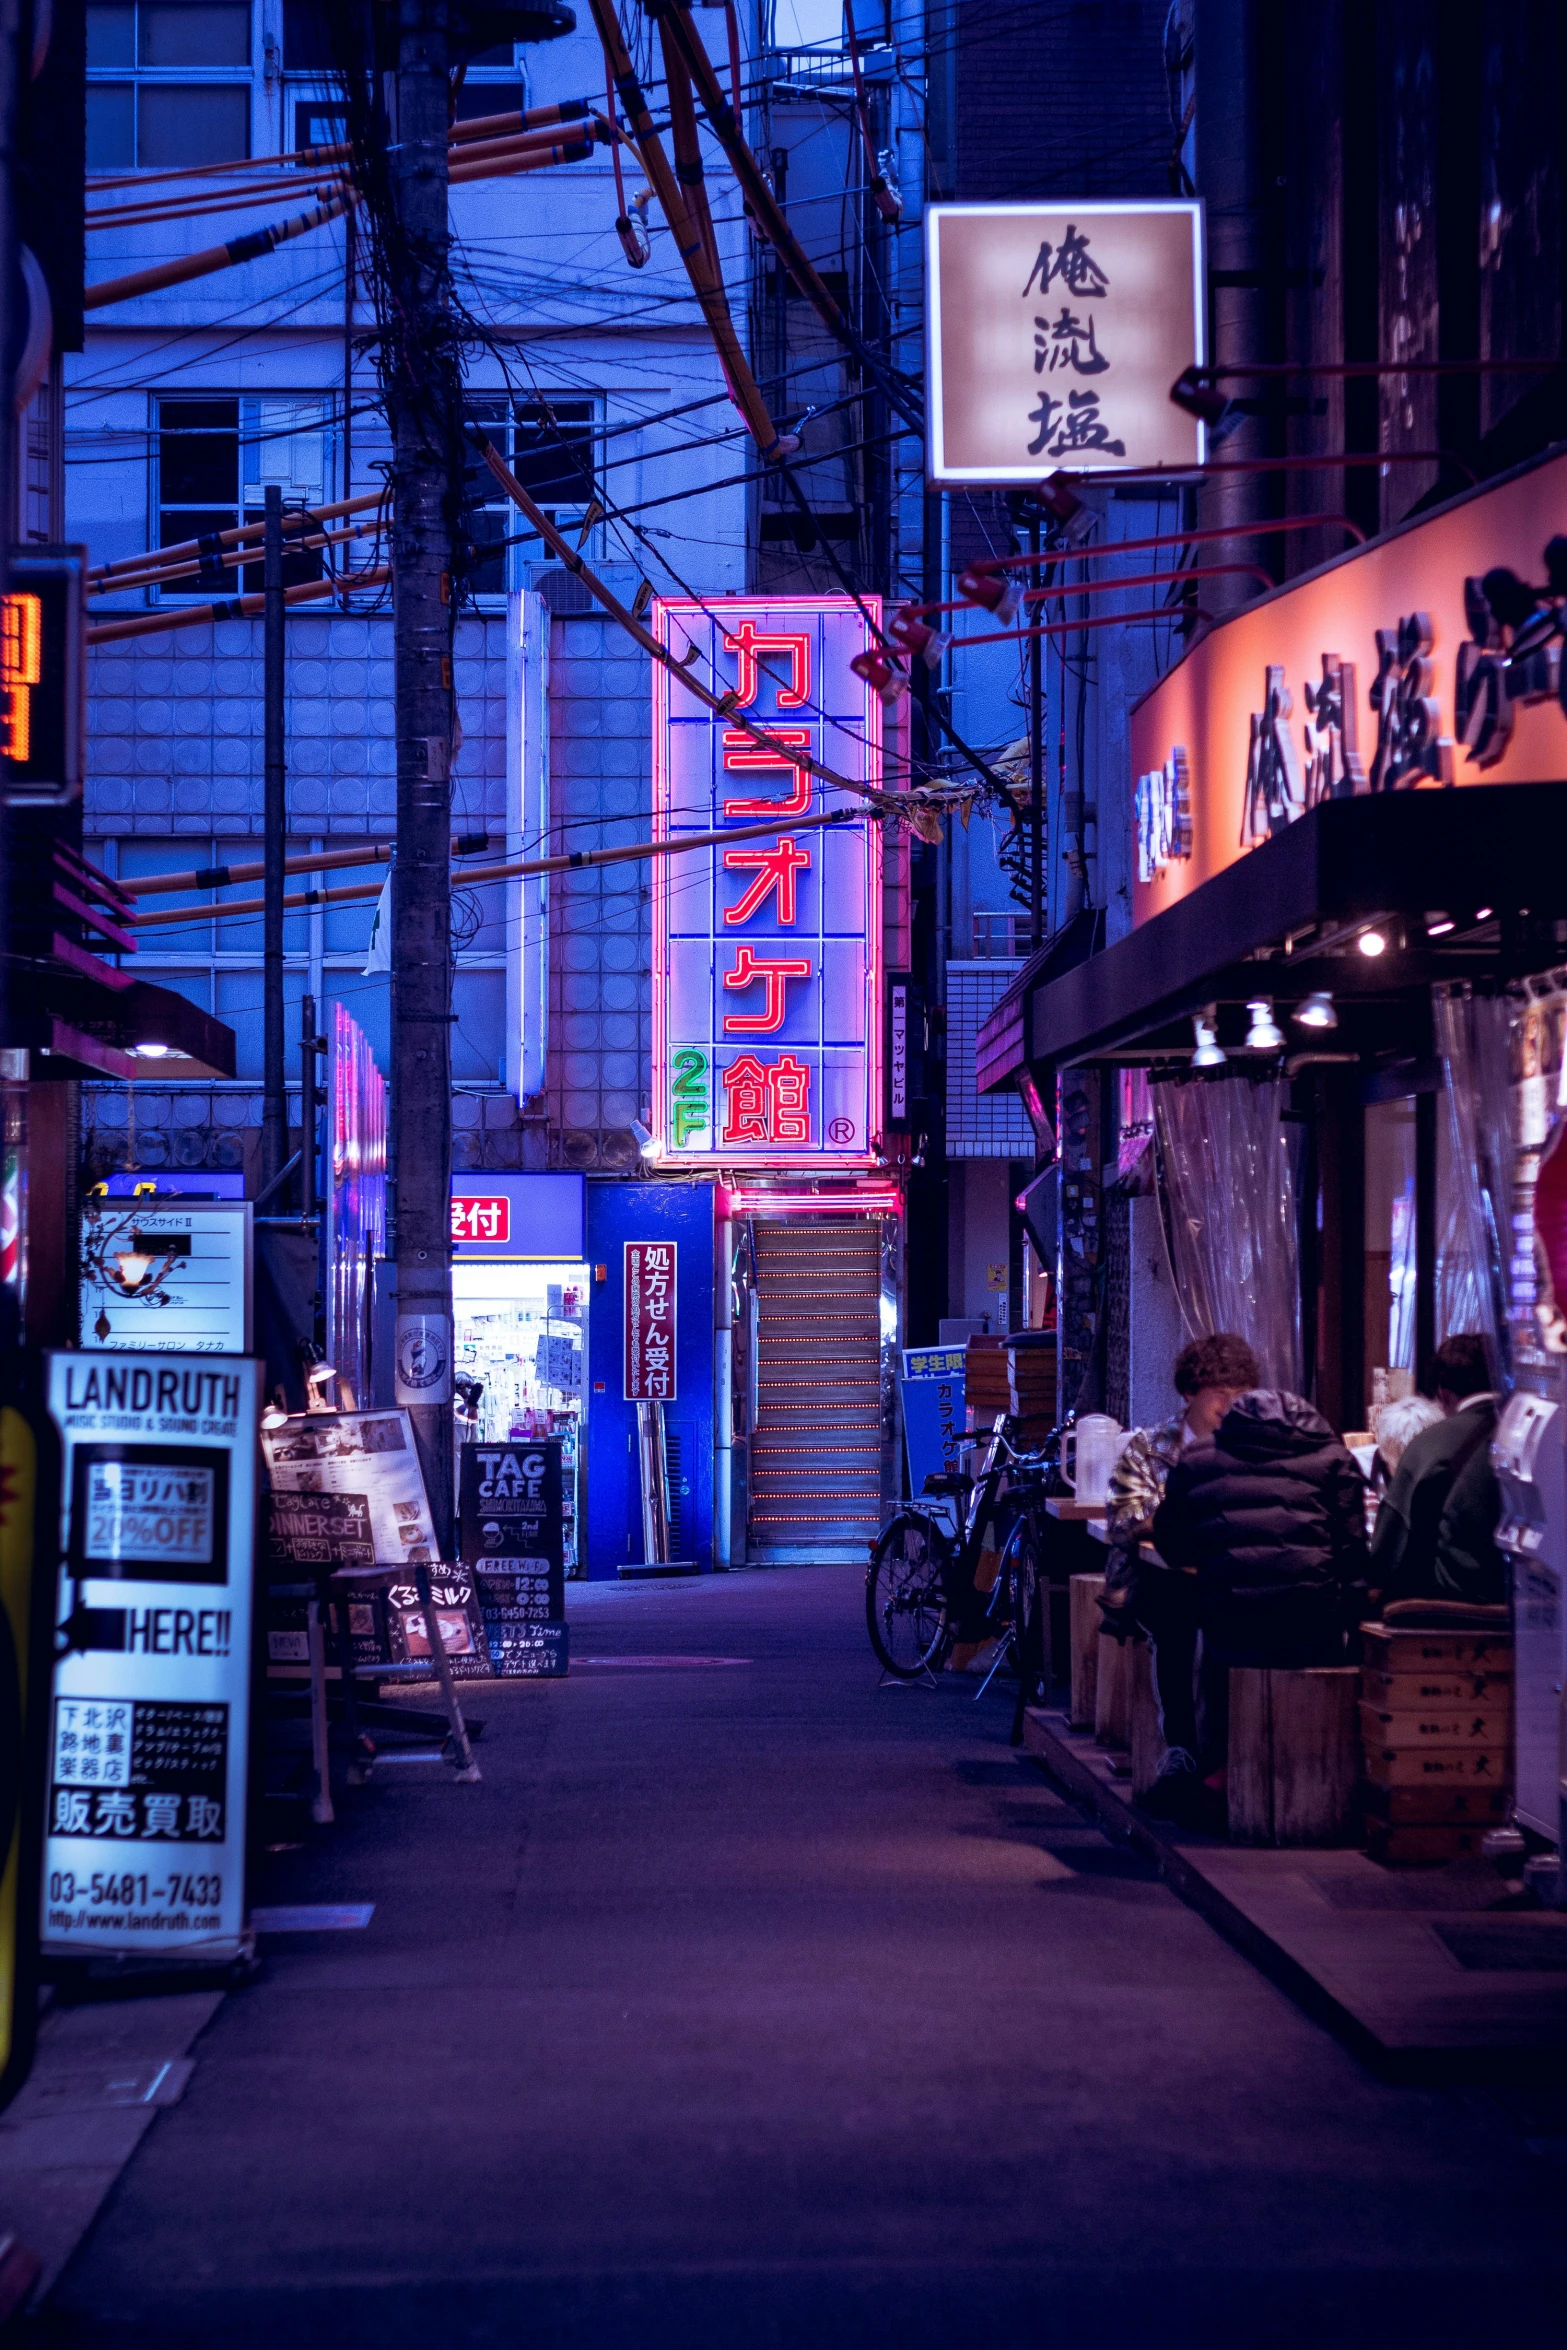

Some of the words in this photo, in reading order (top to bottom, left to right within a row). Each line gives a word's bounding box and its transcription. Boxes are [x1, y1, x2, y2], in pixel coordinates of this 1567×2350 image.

[1021, 223, 1127, 458] 俺流塩
[722, 619, 812, 1145] カラオケ館
[893, 995, 905, 1105] 第一マツヤビル
[671, 1047, 709, 1149] 2F
[643, 1246, 670, 1397] 処方せん受付
[109, 1341, 186, 1351] ファミリーサロン
[195, 1341, 225, 1351] タナカ
[910, 1353, 966, 1373] 学生限
[66, 1366, 240, 1418] LANDRUTH
[65, 1414, 96, 1429] MUSIC
[100, 1415, 142, 1431] STUDIO
[160, 1417, 198, 1434] SOUND
[477, 1453, 546, 1480] TAG
[478, 1480, 542, 1498] CAFE
[92, 1515, 207, 1545] 20%OFF
[521, 1520, 539, 1531] 2nd
[485, 1560, 515, 1572] FREE
[515, 1577, 549, 1592] 12:00
[129, 1607, 232, 1657] HERE!!
[530, 1624, 562, 1637] Time
[63, 1706, 126, 1731] 下北沢
[60, 1731, 125, 1756] 路地裏
[59, 1756, 124, 1781] 楽器店
[52, 1789, 223, 1838] 販売買取
[49, 1871, 222, 1907] 03-5481-7433
[49, 1908, 221, 1933] http://www.landruth.com
